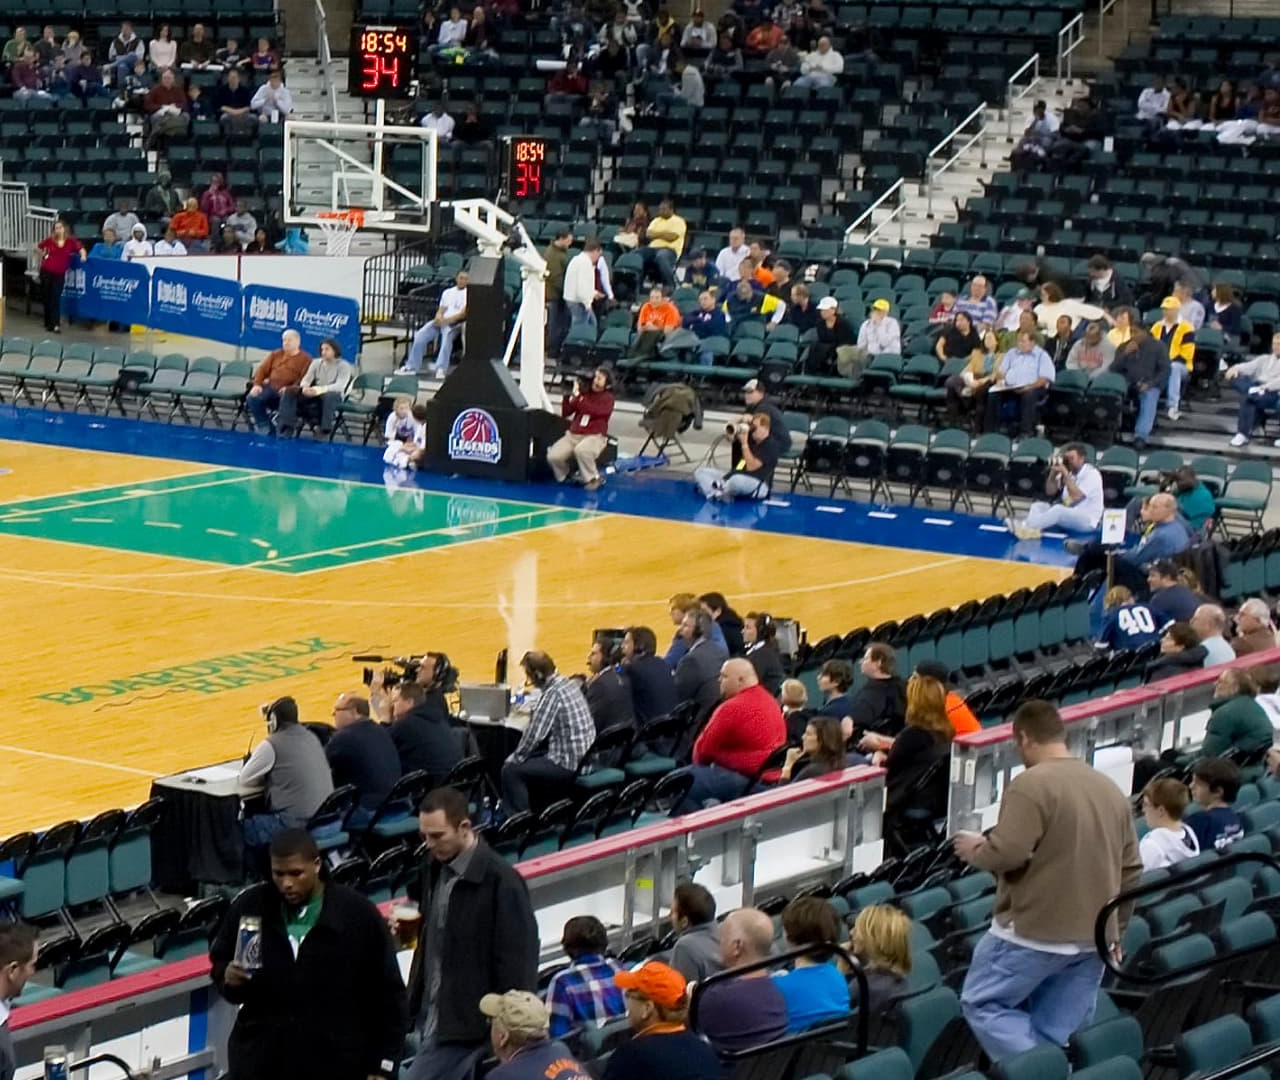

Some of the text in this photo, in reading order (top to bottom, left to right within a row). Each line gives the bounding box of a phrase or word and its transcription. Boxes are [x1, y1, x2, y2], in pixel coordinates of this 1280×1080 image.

[361, 33, 407, 52] 18:54
[363, 55, 398, 88] 34
[516, 142, 544, 161] 18:54
[516, 163, 540, 197] 34
[453, 439, 498, 455] LEGENDS
[1118, 606, 1156, 635] 40
[34, 637, 338, 705] BOARDWALK
[192, 664, 321, 694] HALL
